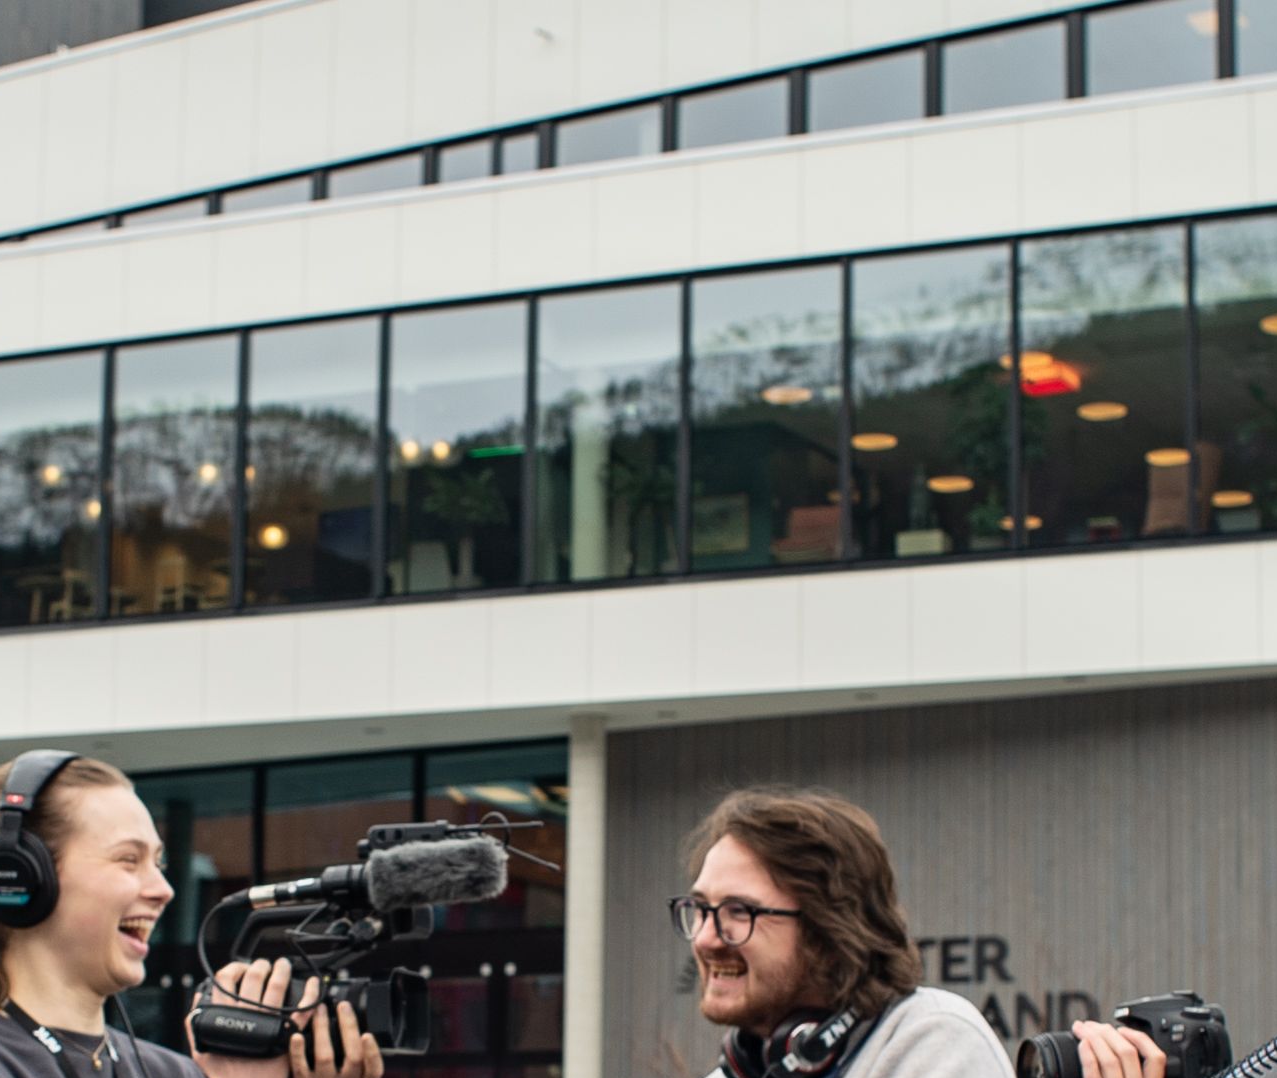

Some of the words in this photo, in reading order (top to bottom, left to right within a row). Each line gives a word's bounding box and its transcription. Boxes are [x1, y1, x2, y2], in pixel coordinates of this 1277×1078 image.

[916, 935, 1014, 984] TER
[215, 1016, 257, 1033] SONY
[980, 989, 1101, 1040] AND
